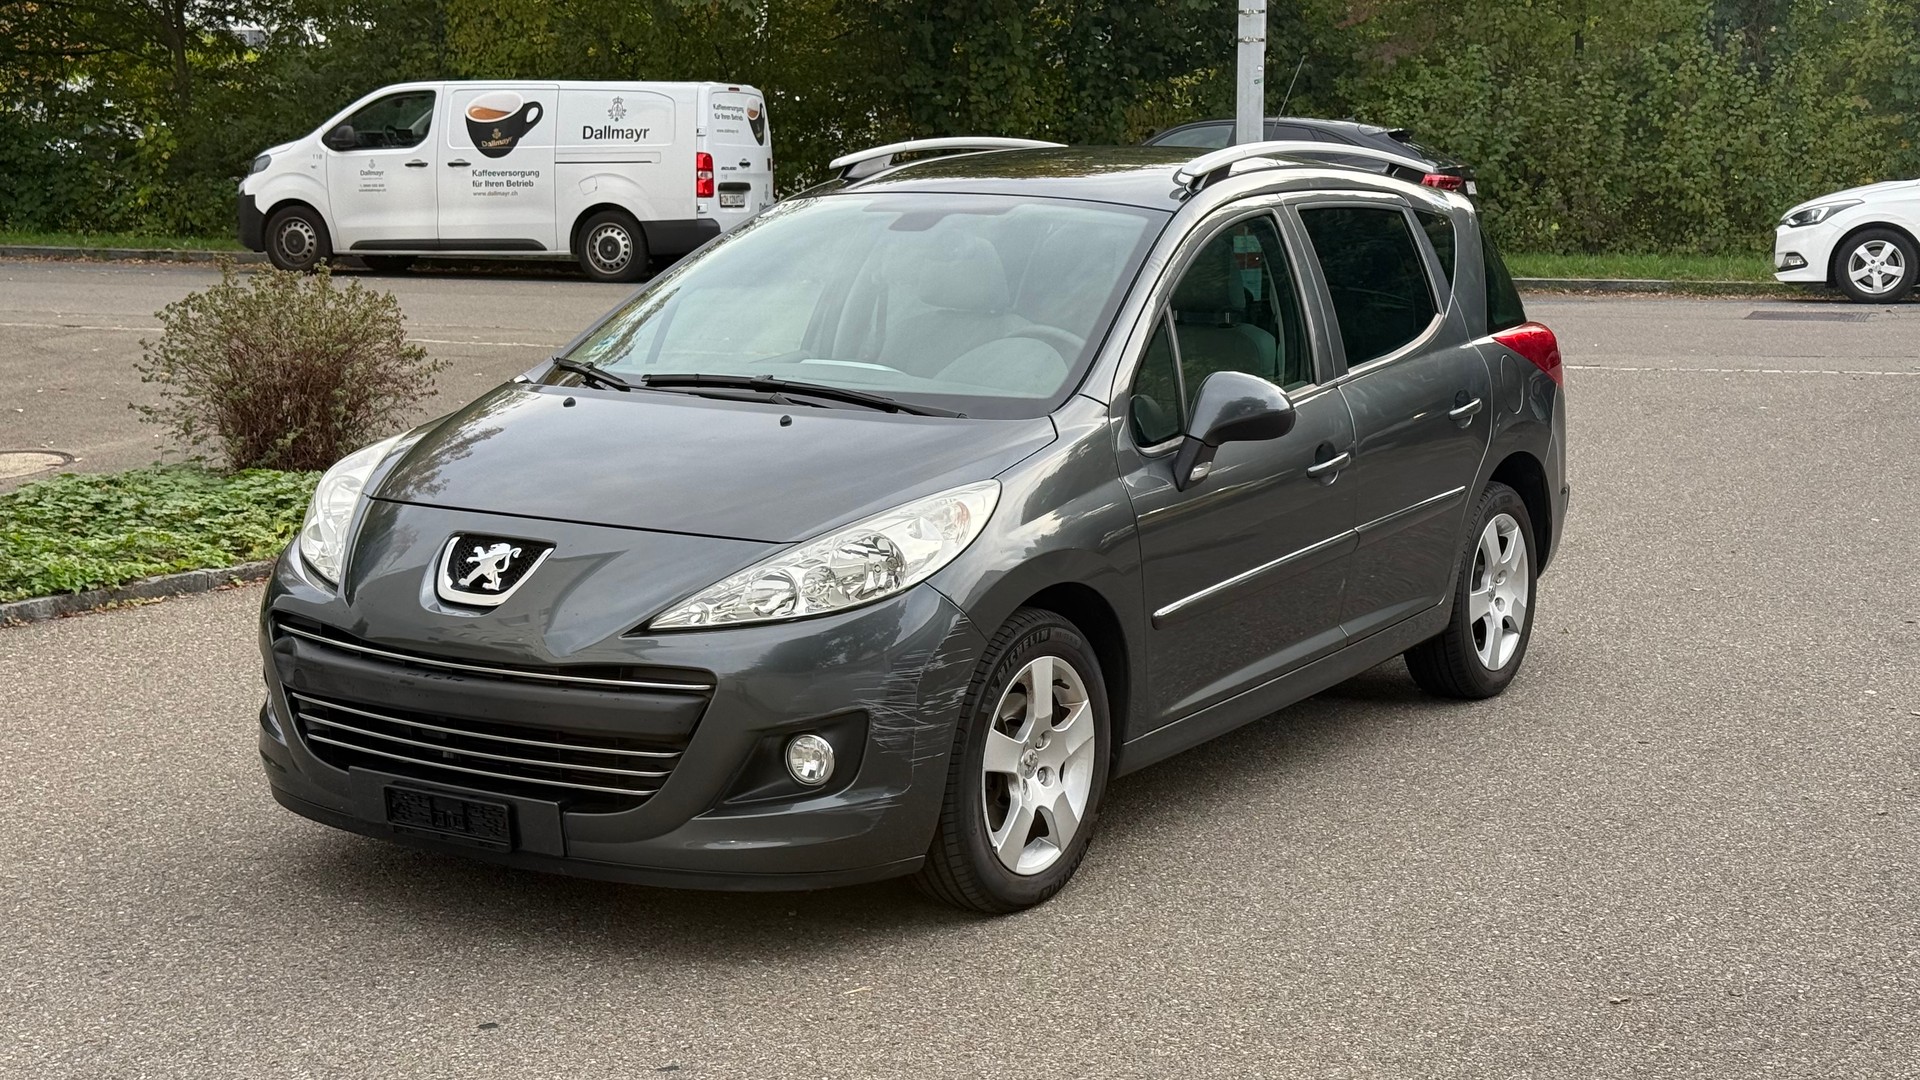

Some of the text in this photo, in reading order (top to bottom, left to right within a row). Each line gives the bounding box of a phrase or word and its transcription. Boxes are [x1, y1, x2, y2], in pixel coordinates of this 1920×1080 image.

[582, 125, 650, 143] Dallmayr
[481, 136, 513, 148] Dallmayr
[360, 169, 385, 177] Dallmayr
[472, 169, 540, 178] Kaffeeversorgung
[472, 180, 534, 188] für Ihren Betrieb
